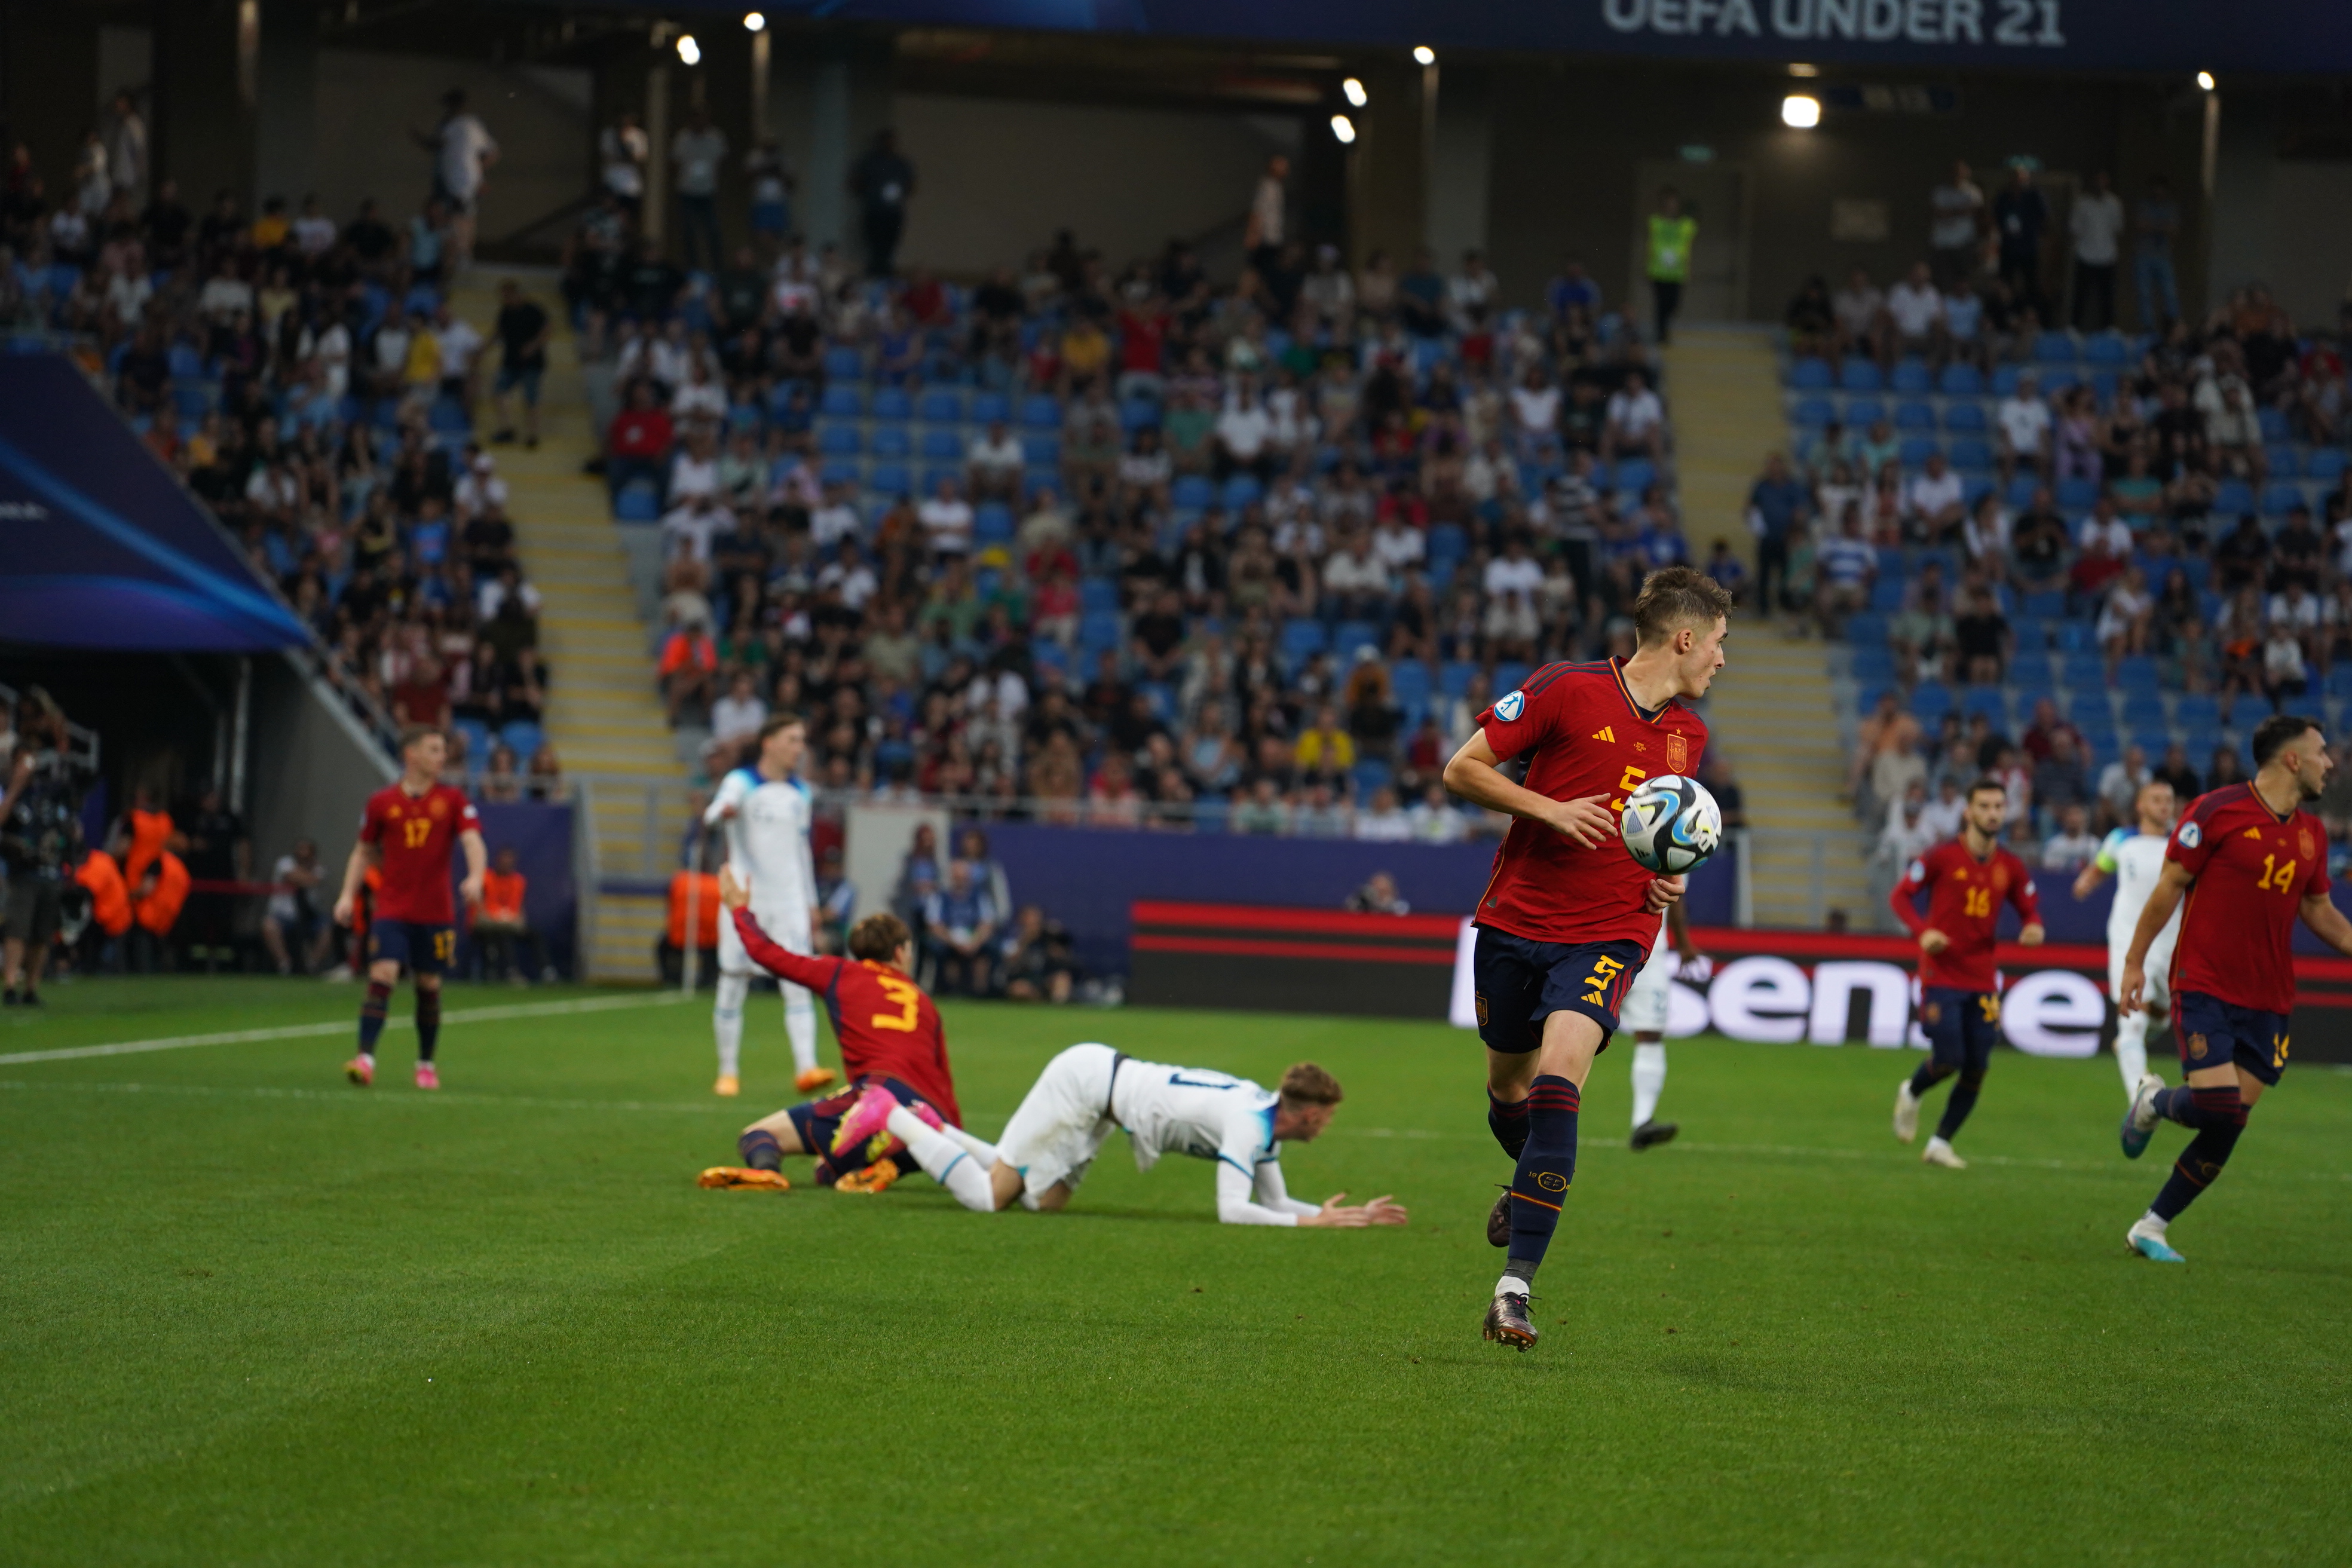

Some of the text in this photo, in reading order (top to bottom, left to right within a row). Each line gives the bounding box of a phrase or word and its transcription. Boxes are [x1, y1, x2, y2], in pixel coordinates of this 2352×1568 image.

[1604, 0, 2065, 46] UEFA UNDER 21
[403, 817, 431, 849] 17
[2258, 853, 2296, 895] 14
[1963, 886, 1990, 918] 16
[1584, 954, 1625, 991] 5
[871, 974, 918, 1033] 3
